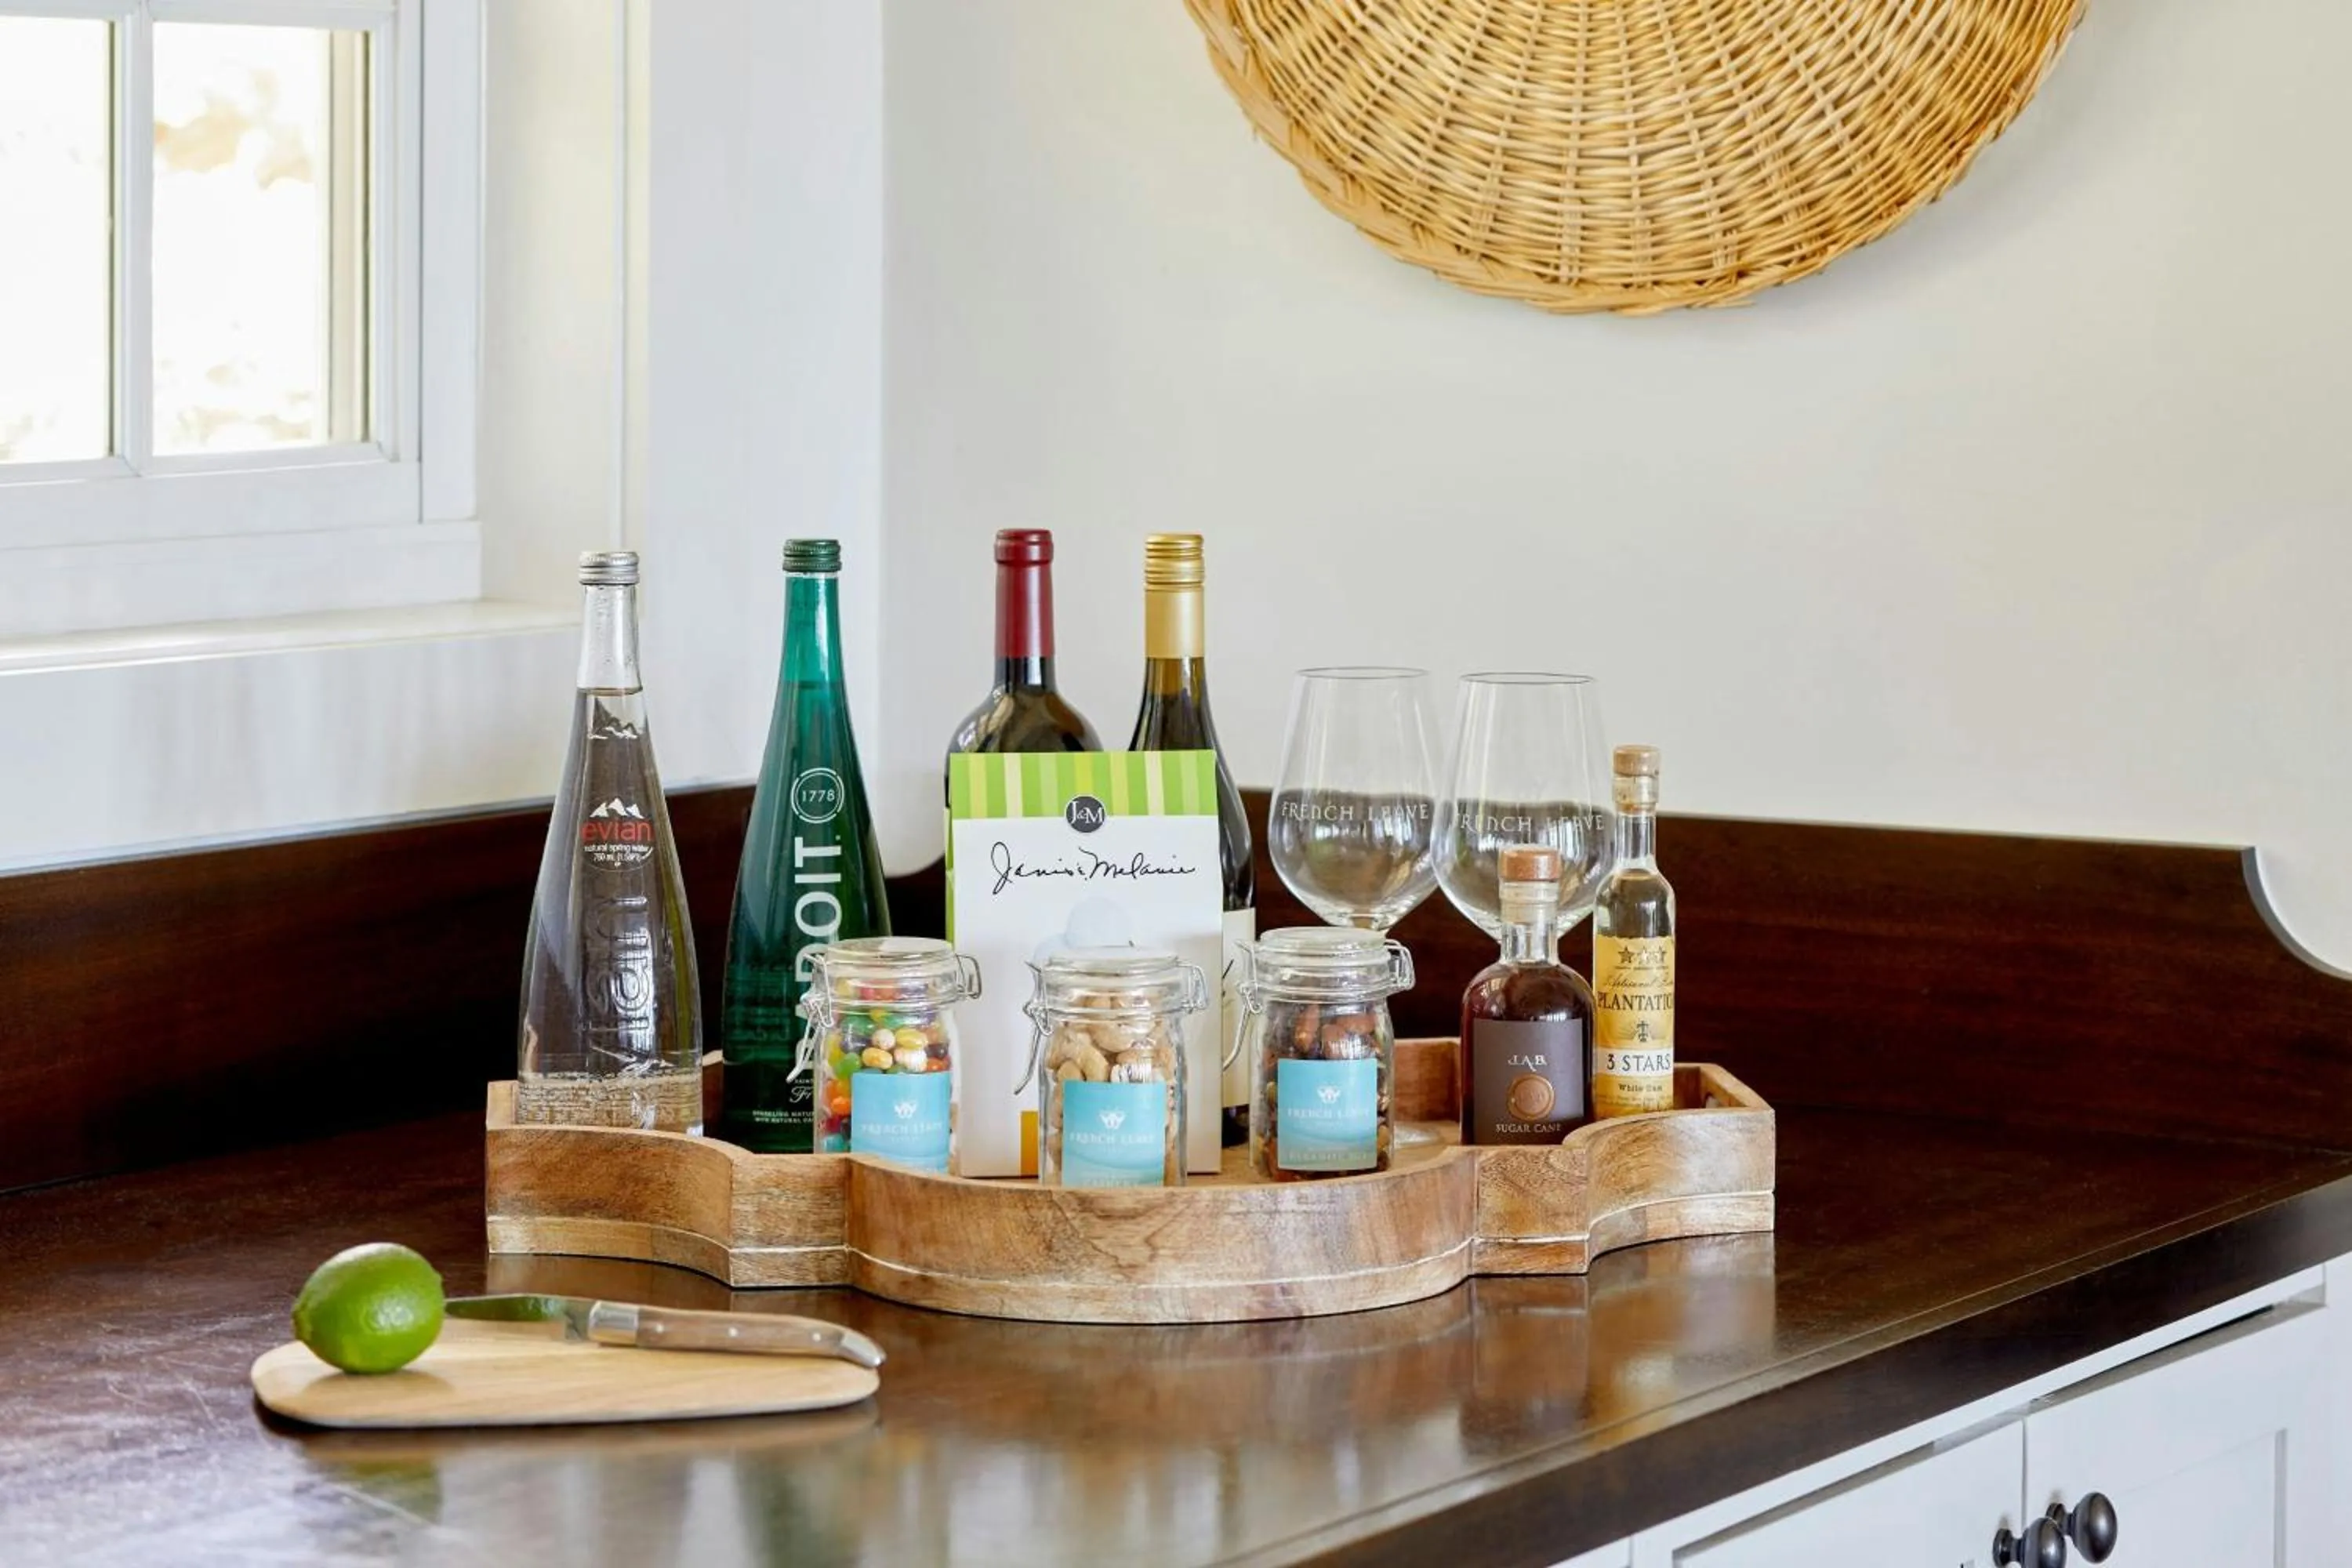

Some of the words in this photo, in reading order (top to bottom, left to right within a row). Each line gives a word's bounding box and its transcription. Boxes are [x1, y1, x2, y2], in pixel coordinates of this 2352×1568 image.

[800, 789, 836, 804] 1778
[1070, 800, 1105, 824] J&M
[1281, 800, 1354, 822] FRENCH
[582, 820, 652, 842] evian
[1606, 1053, 1615, 1071] 3
[1621, 1053, 1671, 1072] STARS
[1496, 1123, 1531, 1134] SUGAR
[1533, 1122, 1562, 1134] CANE
